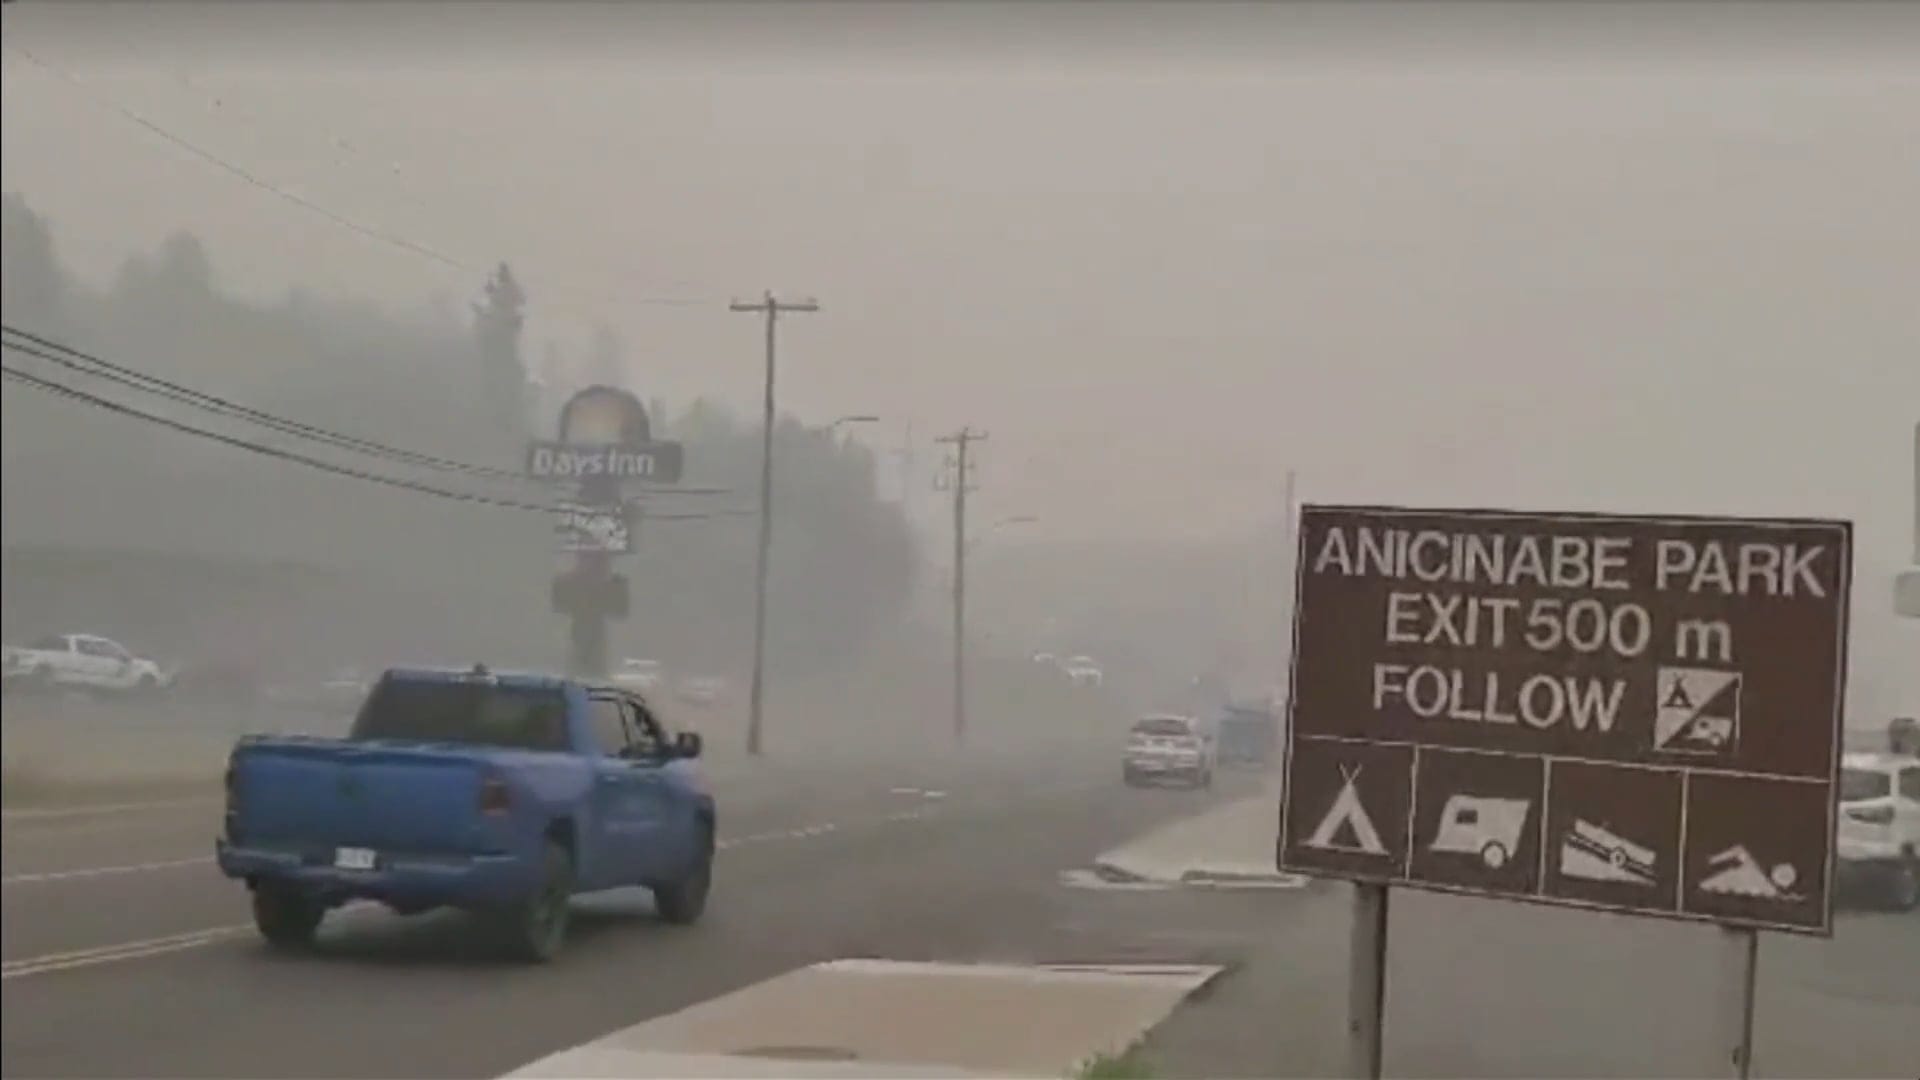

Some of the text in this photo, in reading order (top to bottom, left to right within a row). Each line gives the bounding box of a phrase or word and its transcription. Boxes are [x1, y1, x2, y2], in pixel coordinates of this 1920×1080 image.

[532, 447, 655, 476] Days Inn
[1313, 527, 1826, 597] ANICINABE PARK
[1386, 592, 1732, 662] EXIT 500 m
[1373, 663, 1627, 732] FOLLOW
